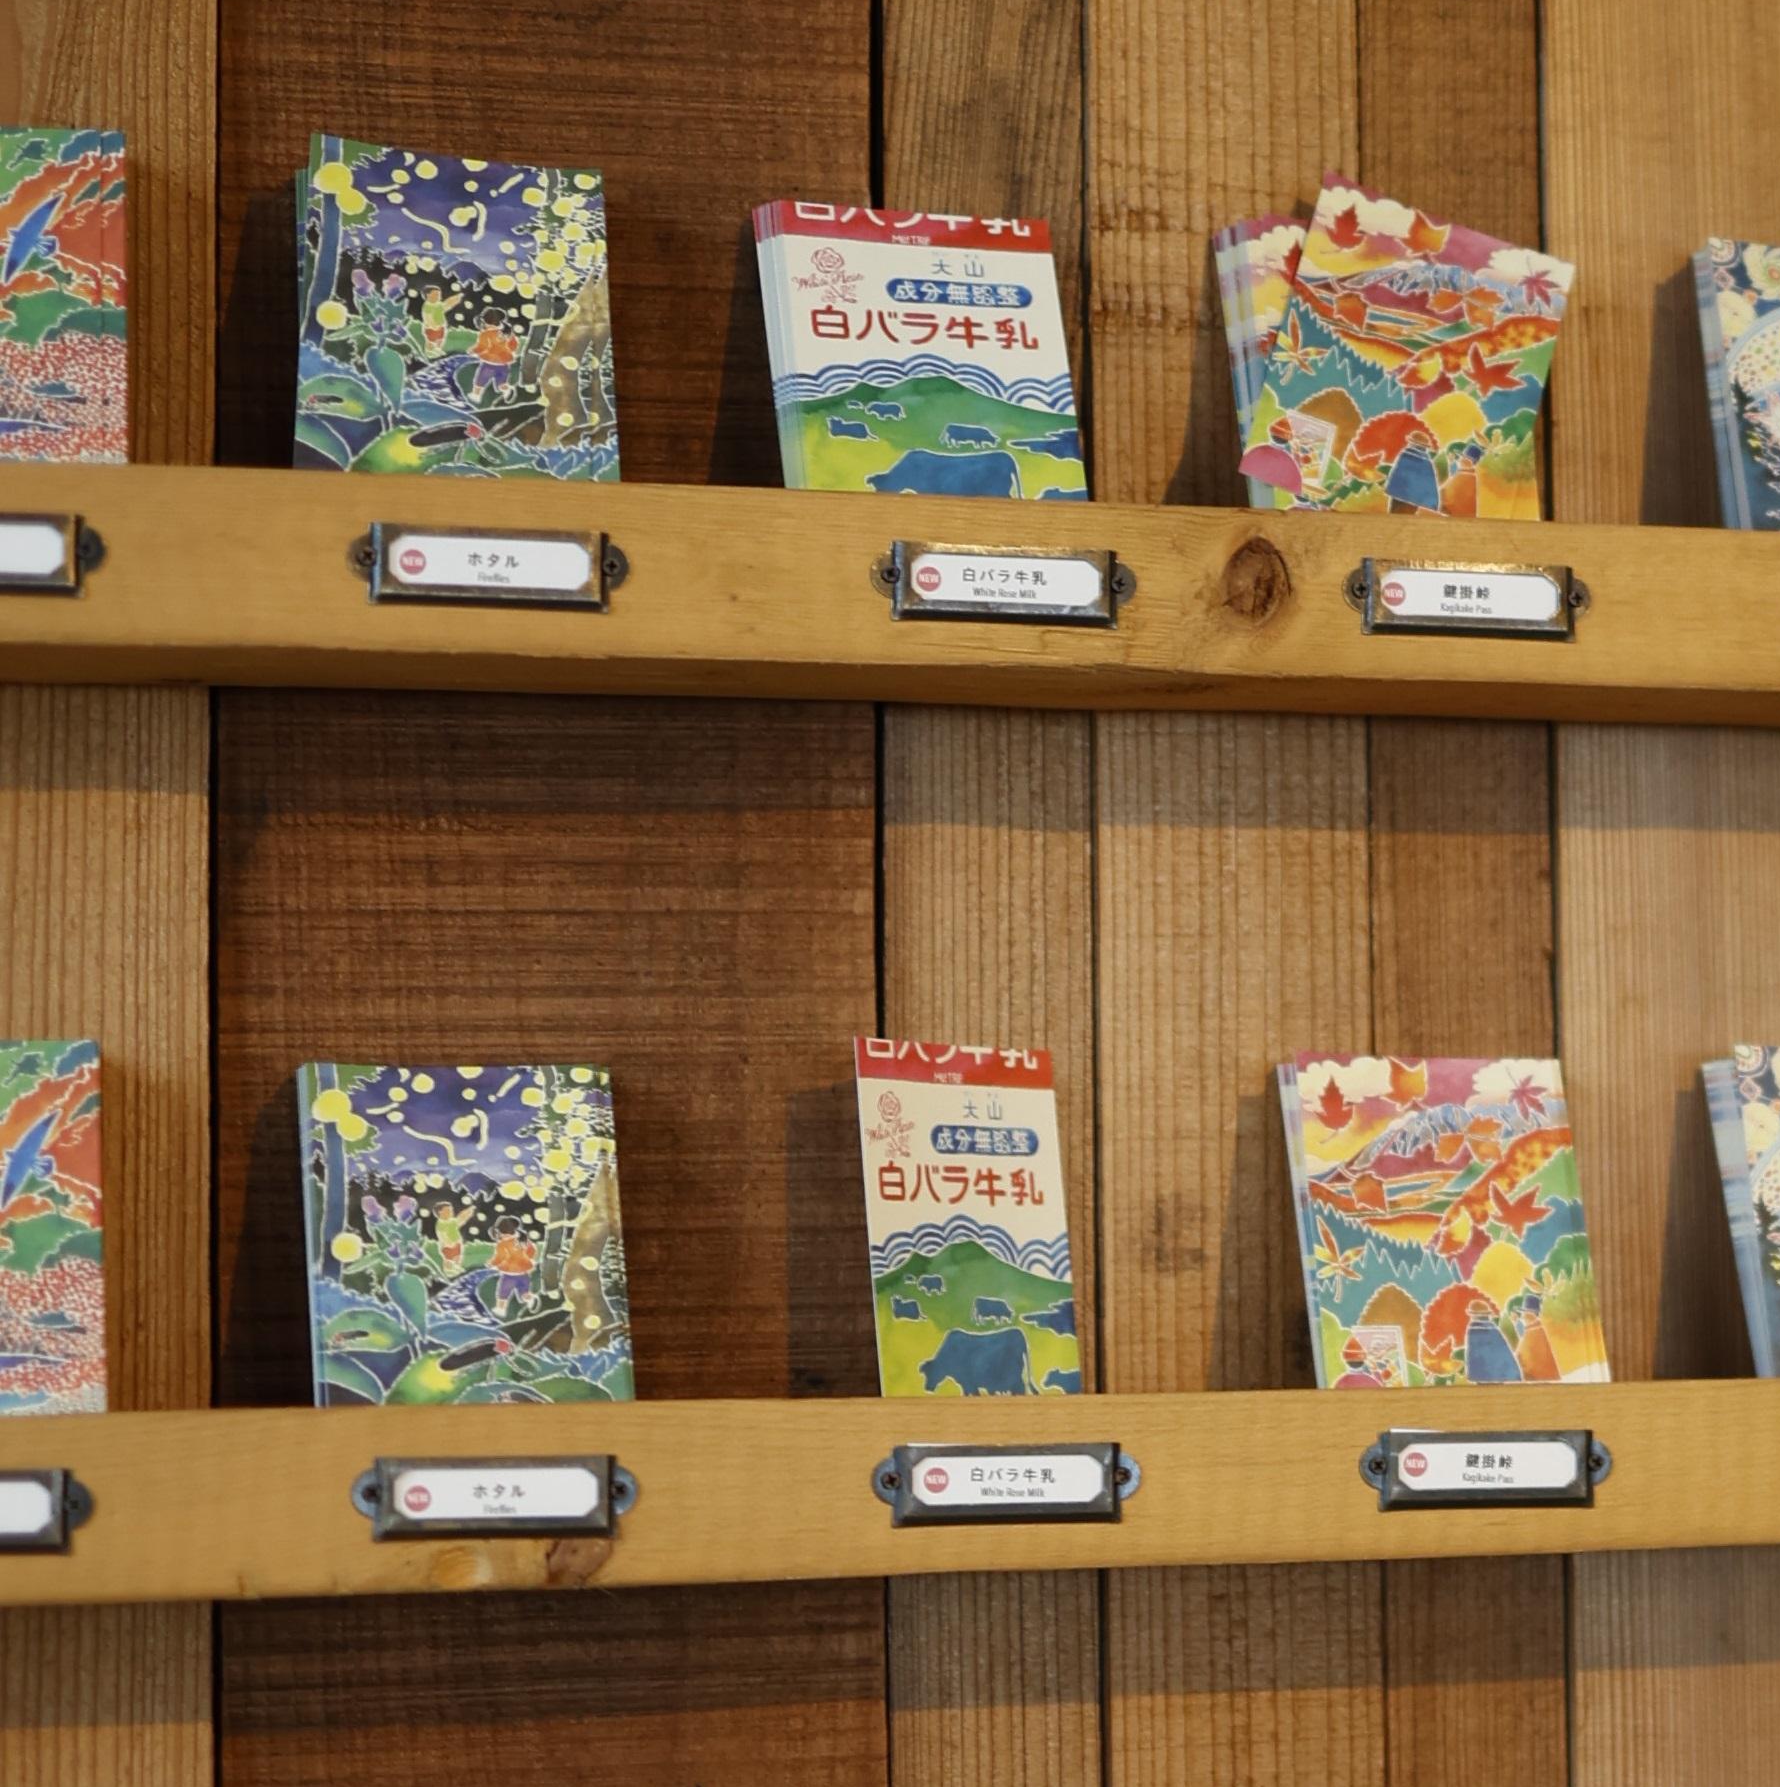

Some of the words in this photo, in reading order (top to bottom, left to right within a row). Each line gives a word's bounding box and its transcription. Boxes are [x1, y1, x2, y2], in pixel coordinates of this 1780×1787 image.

[810, 304, 1040, 351] 白バラ牛乳
[402, 556, 425, 568] NEW
[467, 552, 519, 569] ホタル
[917, 573, 940, 586] NEW
[962, 567, 1048, 587] 白バラ牛乳
[972, 585, 998, 598] White
[999, 587, 1017, 599] Rose
[1018, 588, 1037, 600] Milk
[1382, 588, 1404, 600] NEW
[1442, 583, 1490, 600] 鍵掛峠
[878, 1160, 1045, 1207] 白バラ牛乳
[1405, 1459, 1427, 1471] NEW
[1465, 1453, 1513, 1469] 鍵掛峠
[926, 1475, 947, 1487] NEW
[970, 1467, 1056, 1485] 白バラ牛乳
[472, 1484, 526, 1499] ホタル
[980, 1486, 1005, 1498] White
[1005, 1486, 1024, 1498] Rose
[1026, 1486, 1046, 1498] Milk
